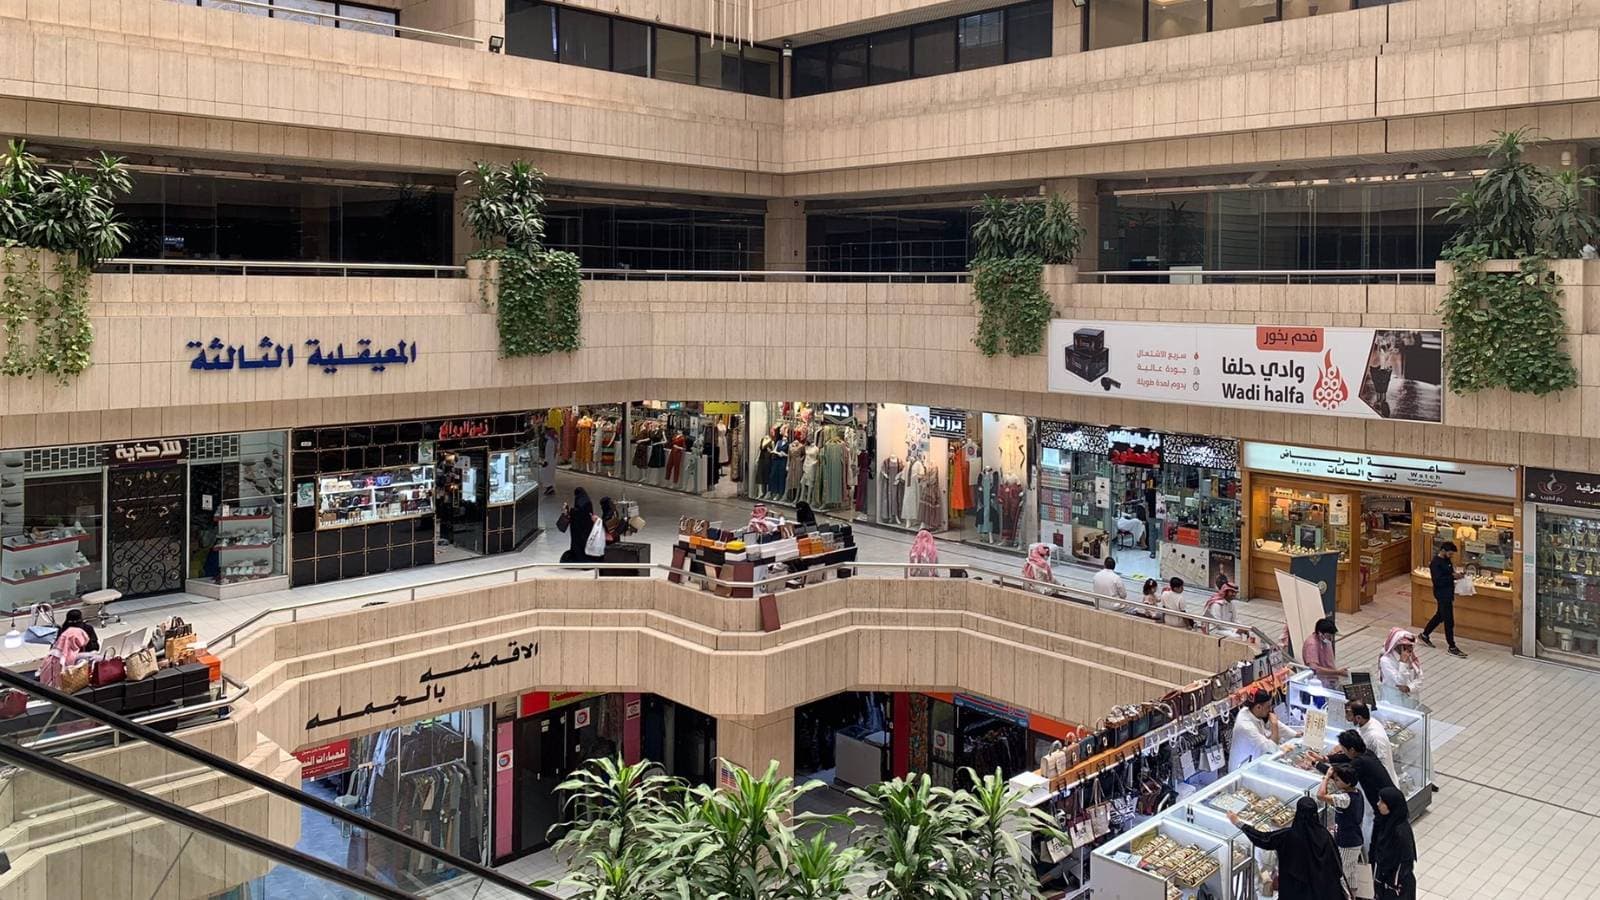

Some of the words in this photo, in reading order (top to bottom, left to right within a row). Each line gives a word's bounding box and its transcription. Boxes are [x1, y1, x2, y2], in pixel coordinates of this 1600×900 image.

[1263, 330, 1289, 345] بخور
[1291, 330, 1318, 346] فحم
[186, 335, 294, 371] الثالثة
[305, 338, 417, 375] المعيقلية
[1221, 356, 1256, 376] حلفا
[1260, 359, 1306, 383] وادي
[1221, 382, 1260, 401] Wadi
[1264, 385, 1305, 404] halfa
[1279, 448, 1364, 466] الرياض
[1366, 455, 1467, 475] ساعة
[1326, 464, 1365, 478] الساعات
[1366, 470, 1398, 483] لبيع
